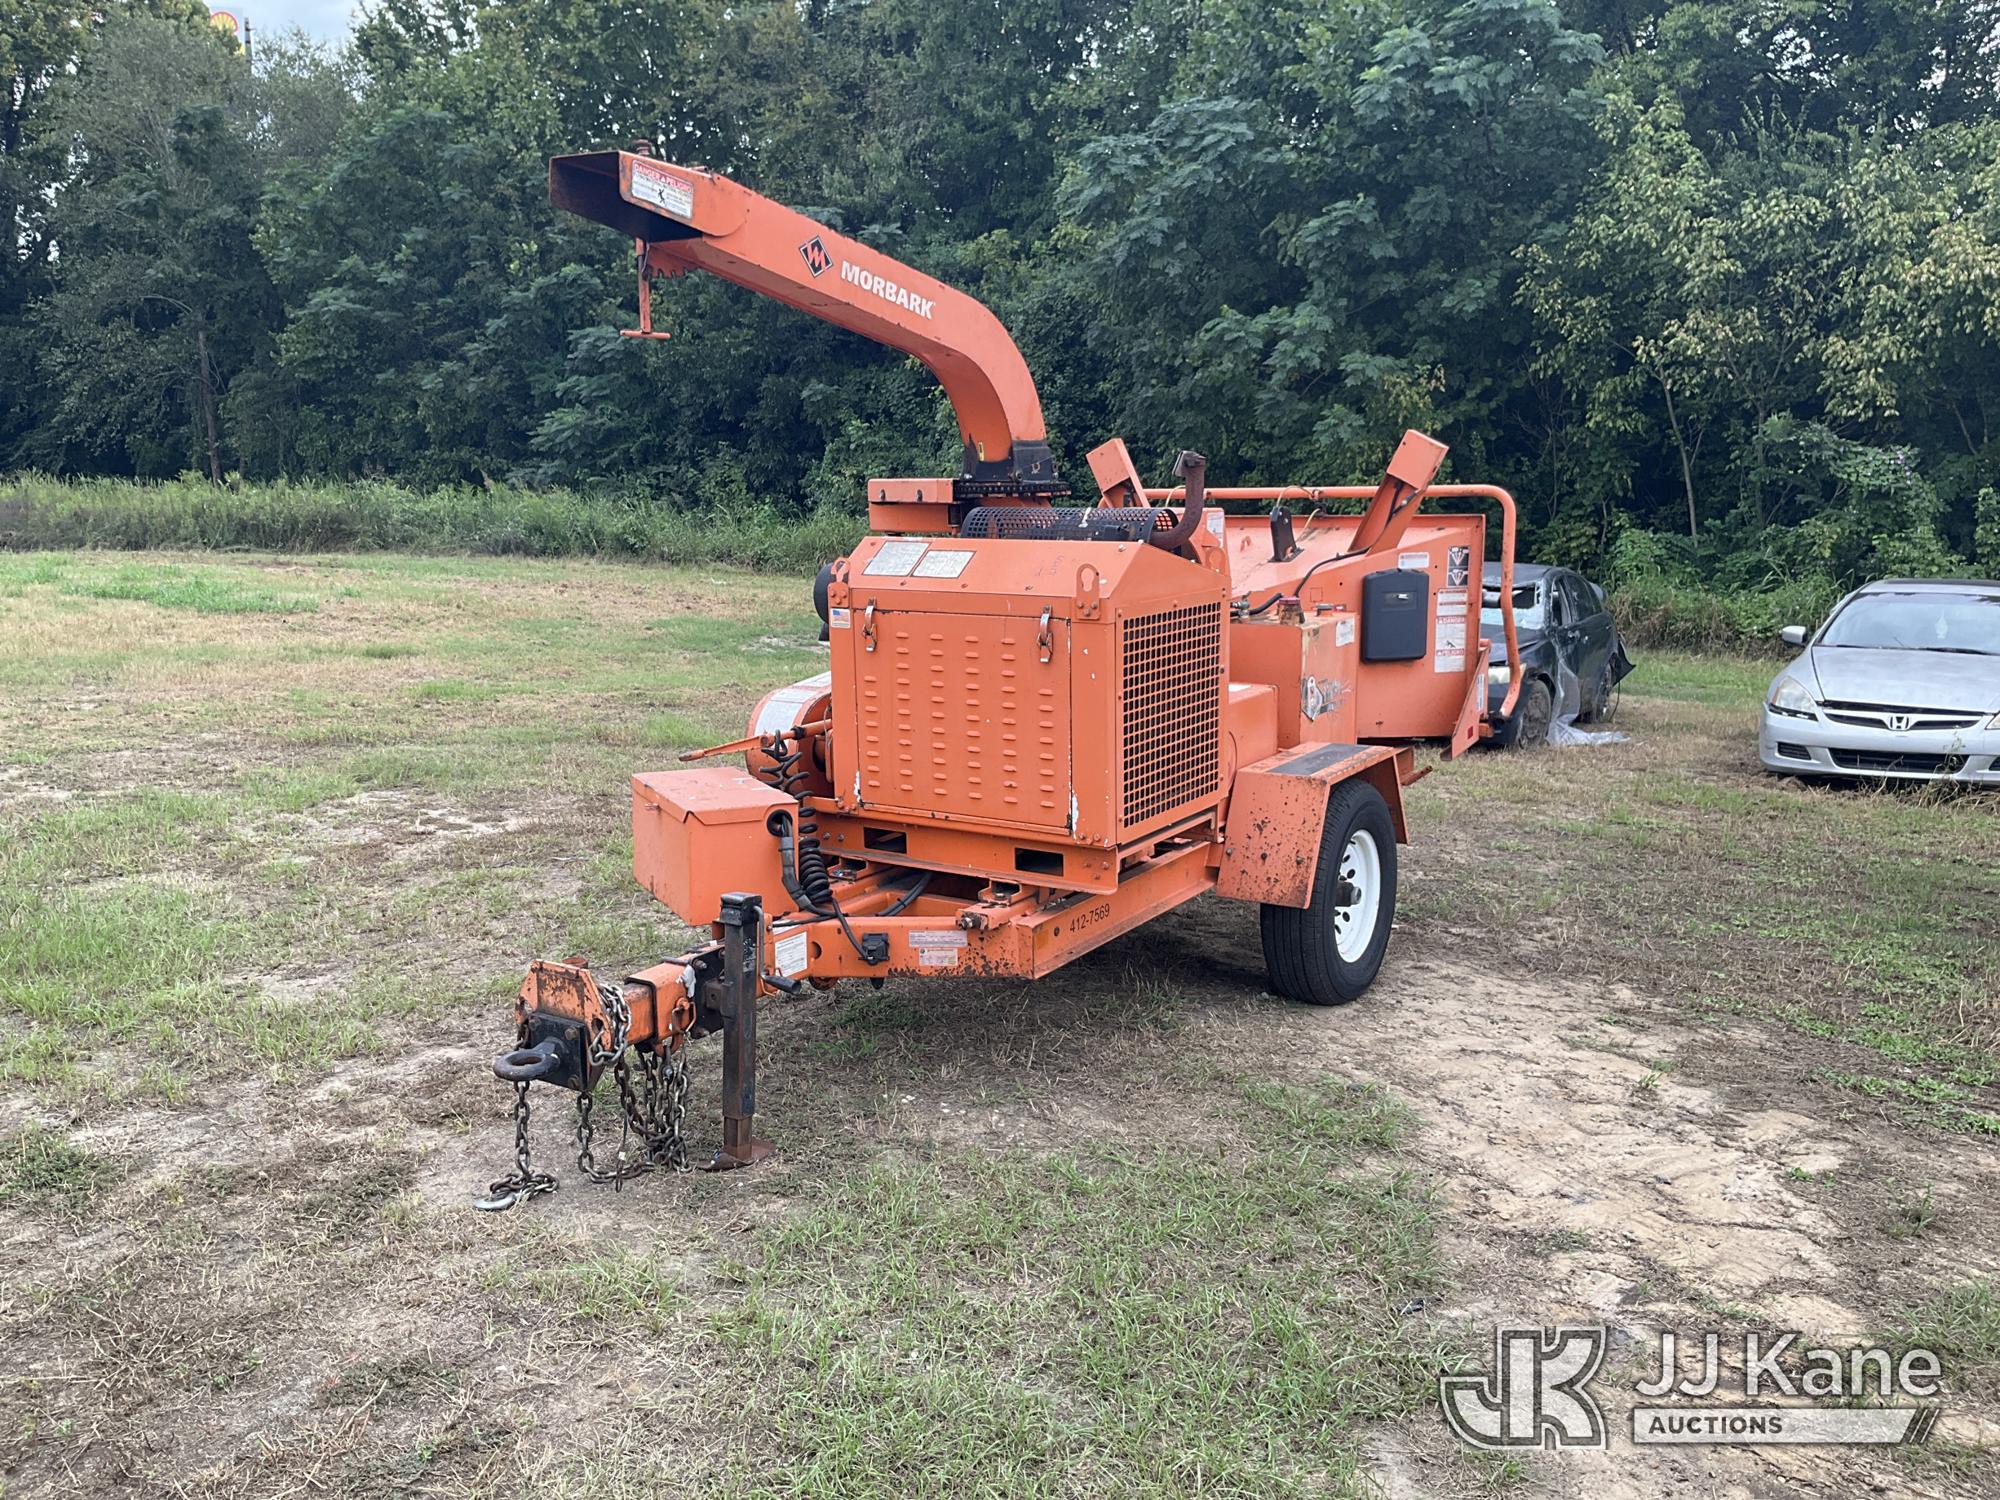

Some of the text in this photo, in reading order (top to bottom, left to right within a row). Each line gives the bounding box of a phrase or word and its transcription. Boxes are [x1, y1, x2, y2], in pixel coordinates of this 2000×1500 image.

[634, 163, 661, 182] DANGER
[841, 260, 933, 320] MORBARK
[1069, 903, 1110, 933] 412-7569
